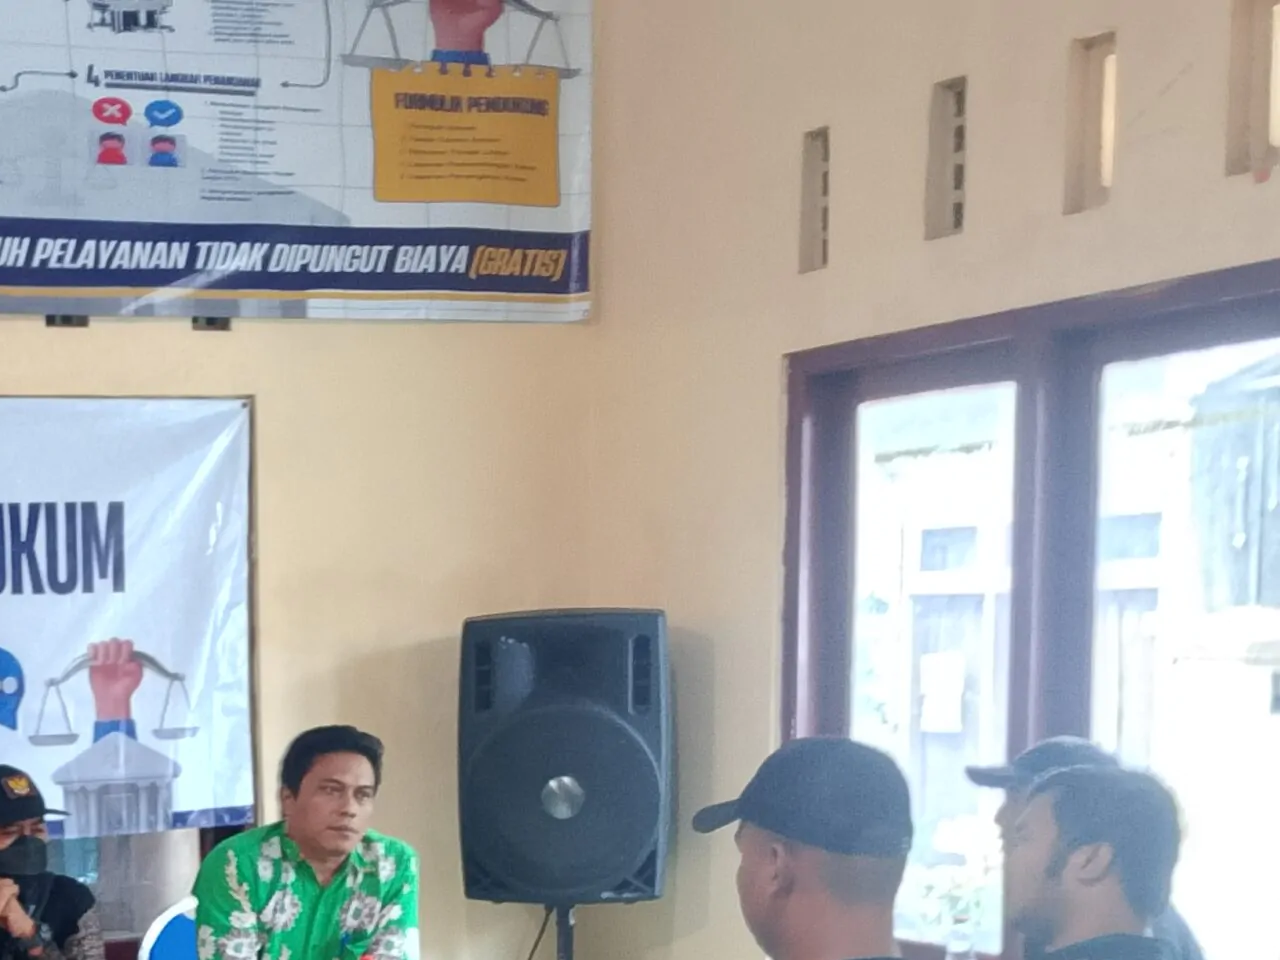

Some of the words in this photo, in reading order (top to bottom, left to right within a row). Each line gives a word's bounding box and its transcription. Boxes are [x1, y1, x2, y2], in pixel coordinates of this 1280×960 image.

[87, 64, 100, 87] 4
[31, 237, 190, 270] PELAYANAN
[194, 241, 272, 272] TIDAK
[268, 244, 392, 274] DIPUNGUT
[393, 245, 469, 274] BIAYA
